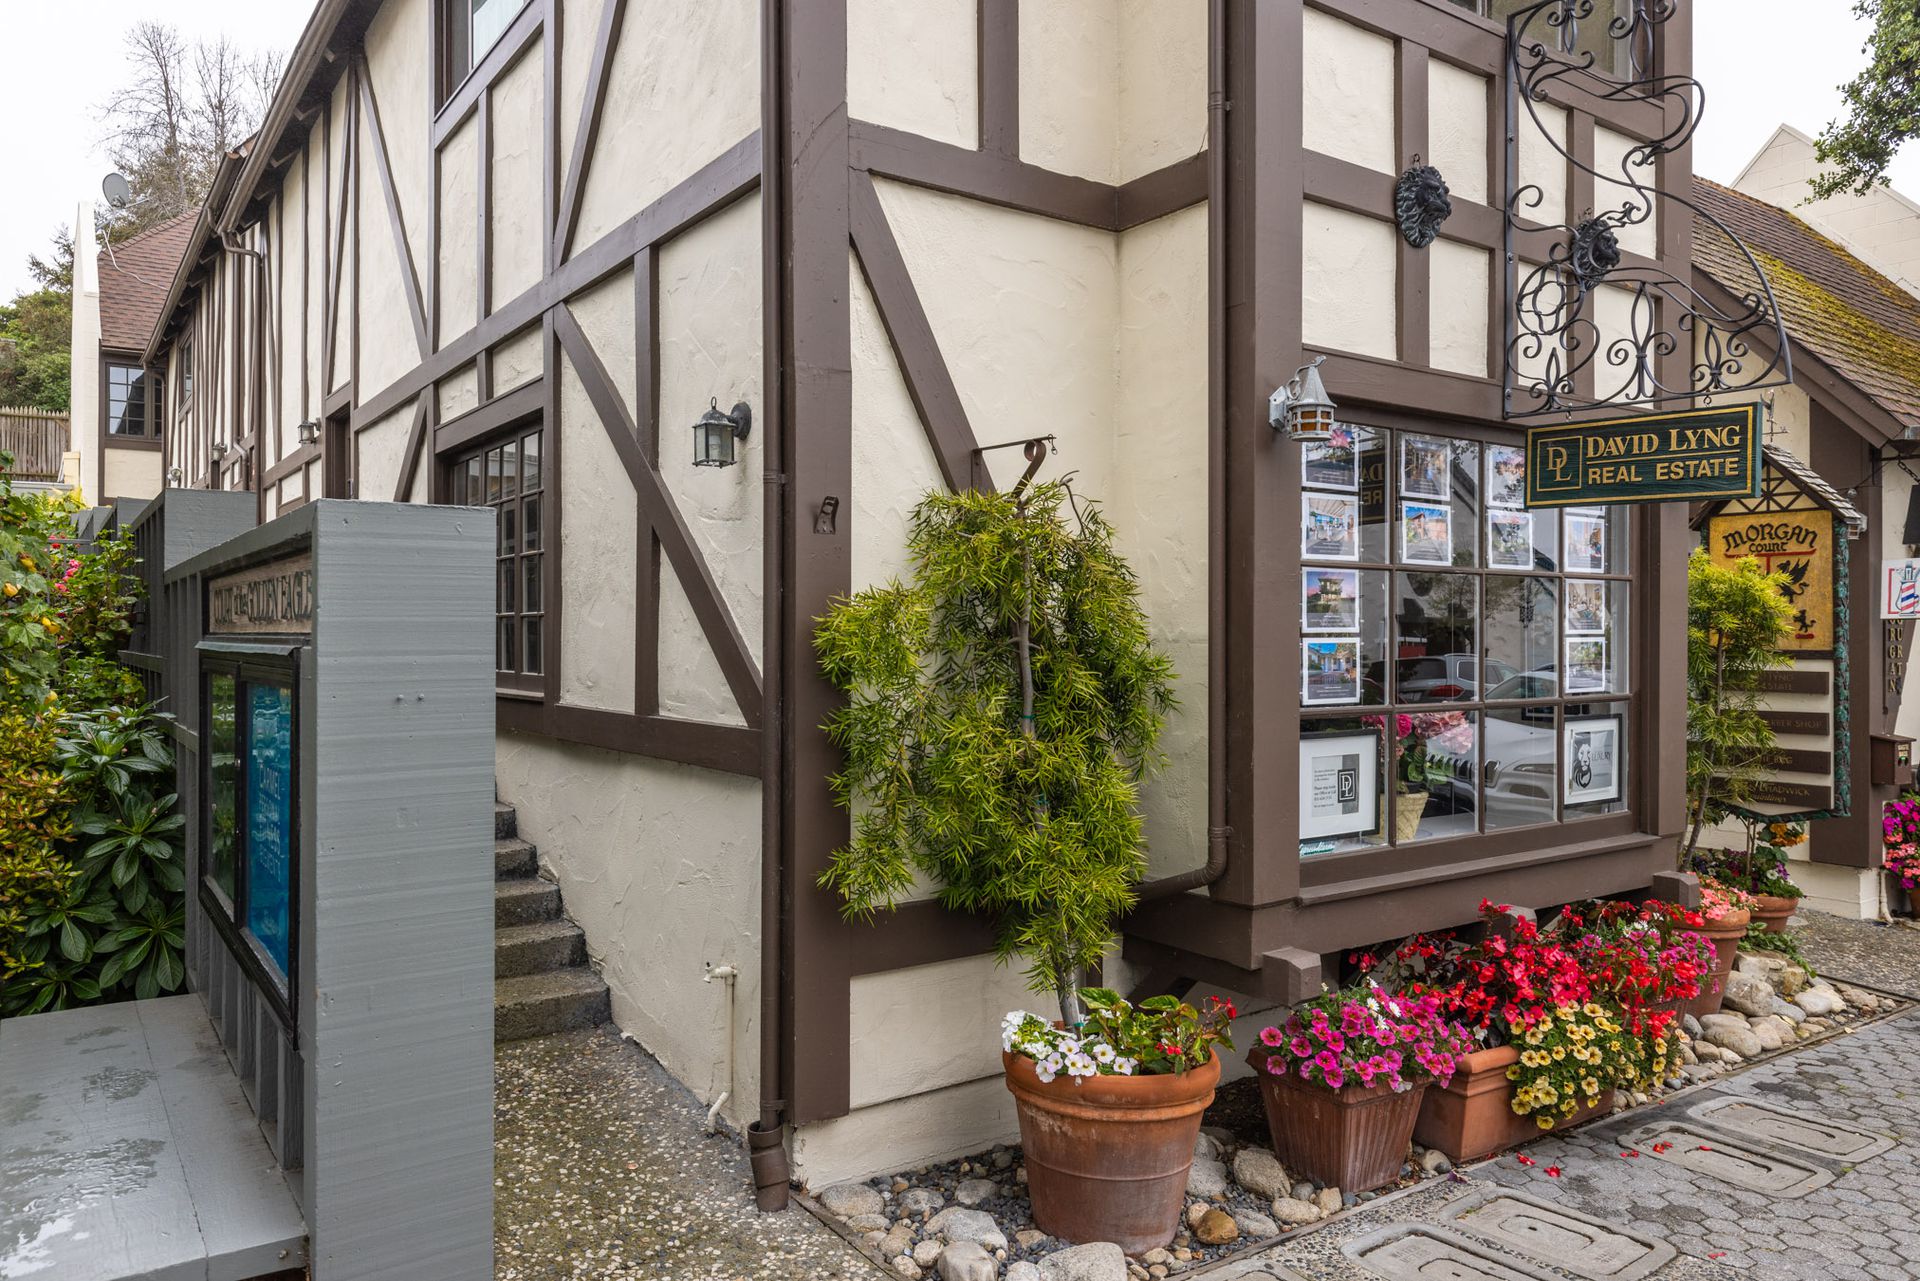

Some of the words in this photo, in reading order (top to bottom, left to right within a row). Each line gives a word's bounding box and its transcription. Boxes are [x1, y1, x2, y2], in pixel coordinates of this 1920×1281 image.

[1586, 433, 1659, 458] DAVID
[1669, 425, 1741, 451] LYNG
[1588, 464, 1643, 485] REAL
[1655, 457, 1740, 481] ESTATE
